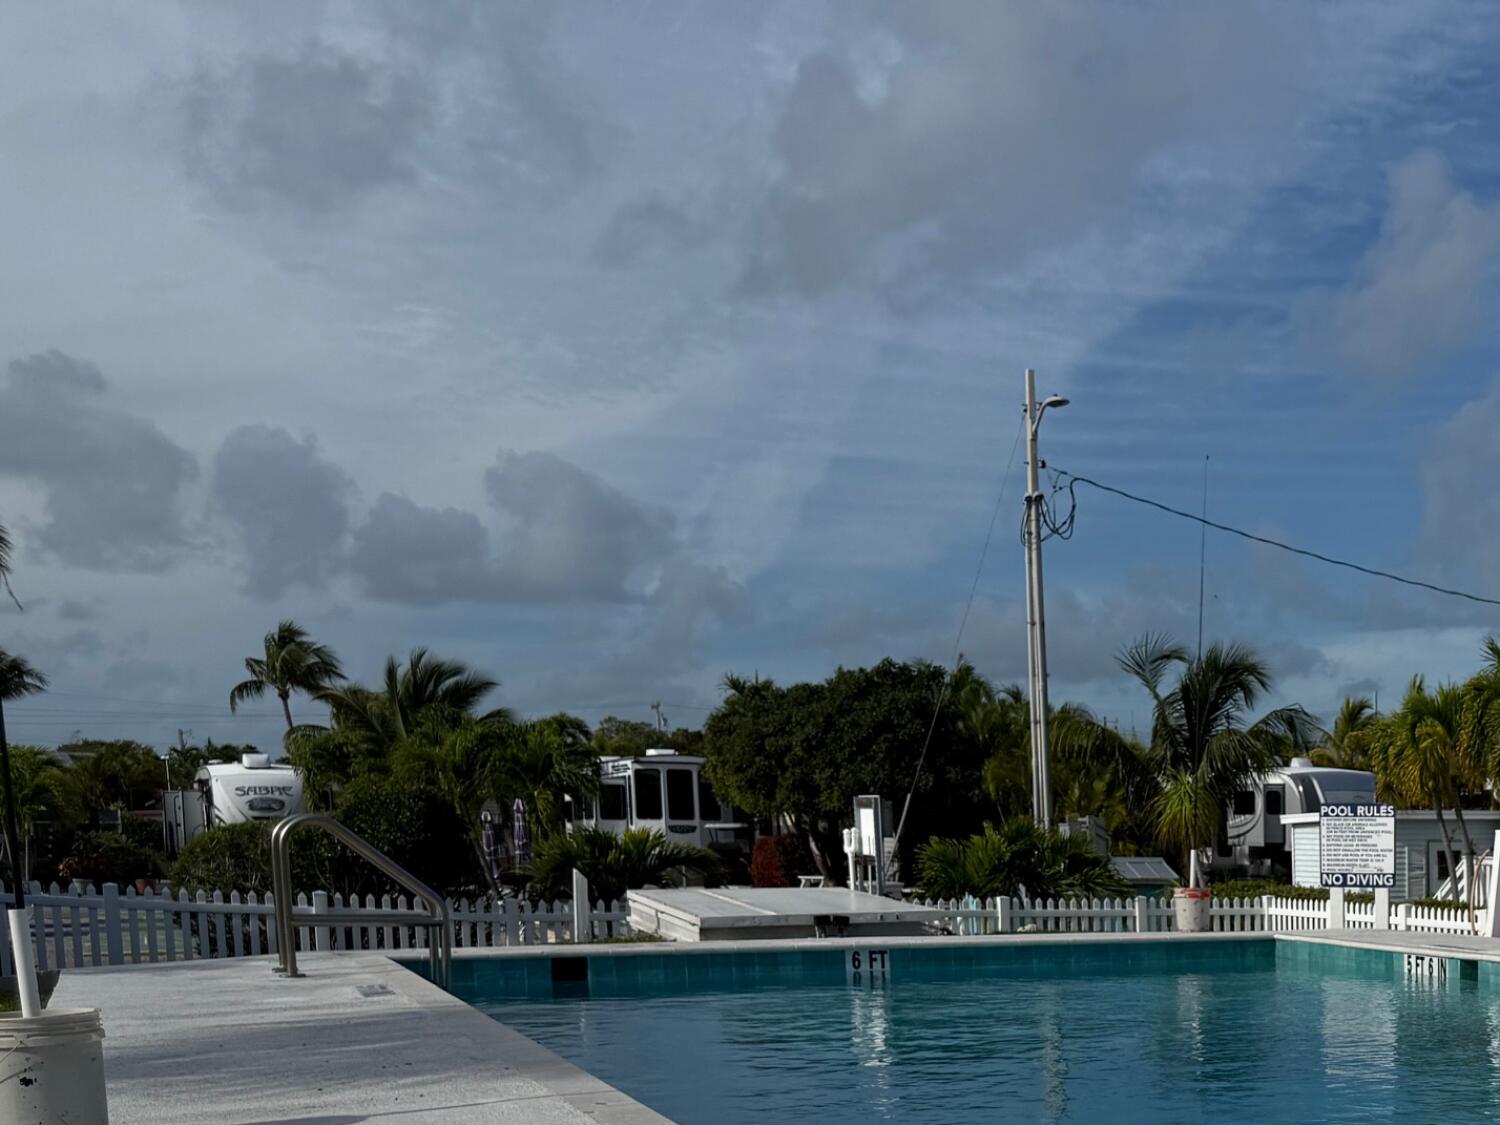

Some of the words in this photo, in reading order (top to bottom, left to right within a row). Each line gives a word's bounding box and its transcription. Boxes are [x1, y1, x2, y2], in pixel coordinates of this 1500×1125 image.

[1321, 805, 1354, 817] POOL
[1357, 805, 1394, 817] RULES
[1322, 874, 1344, 886] NO
[1347, 874, 1394, 886] DIVING
[851, 950, 862, 970] 6
[868, 950, 888, 970] FT
[1407, 954, 1412, 975] 5
[1415, 955, 1425, 977] FT
[1428, 957, 1434, 977] 6
[1437, 957, 1447, 979] IN
